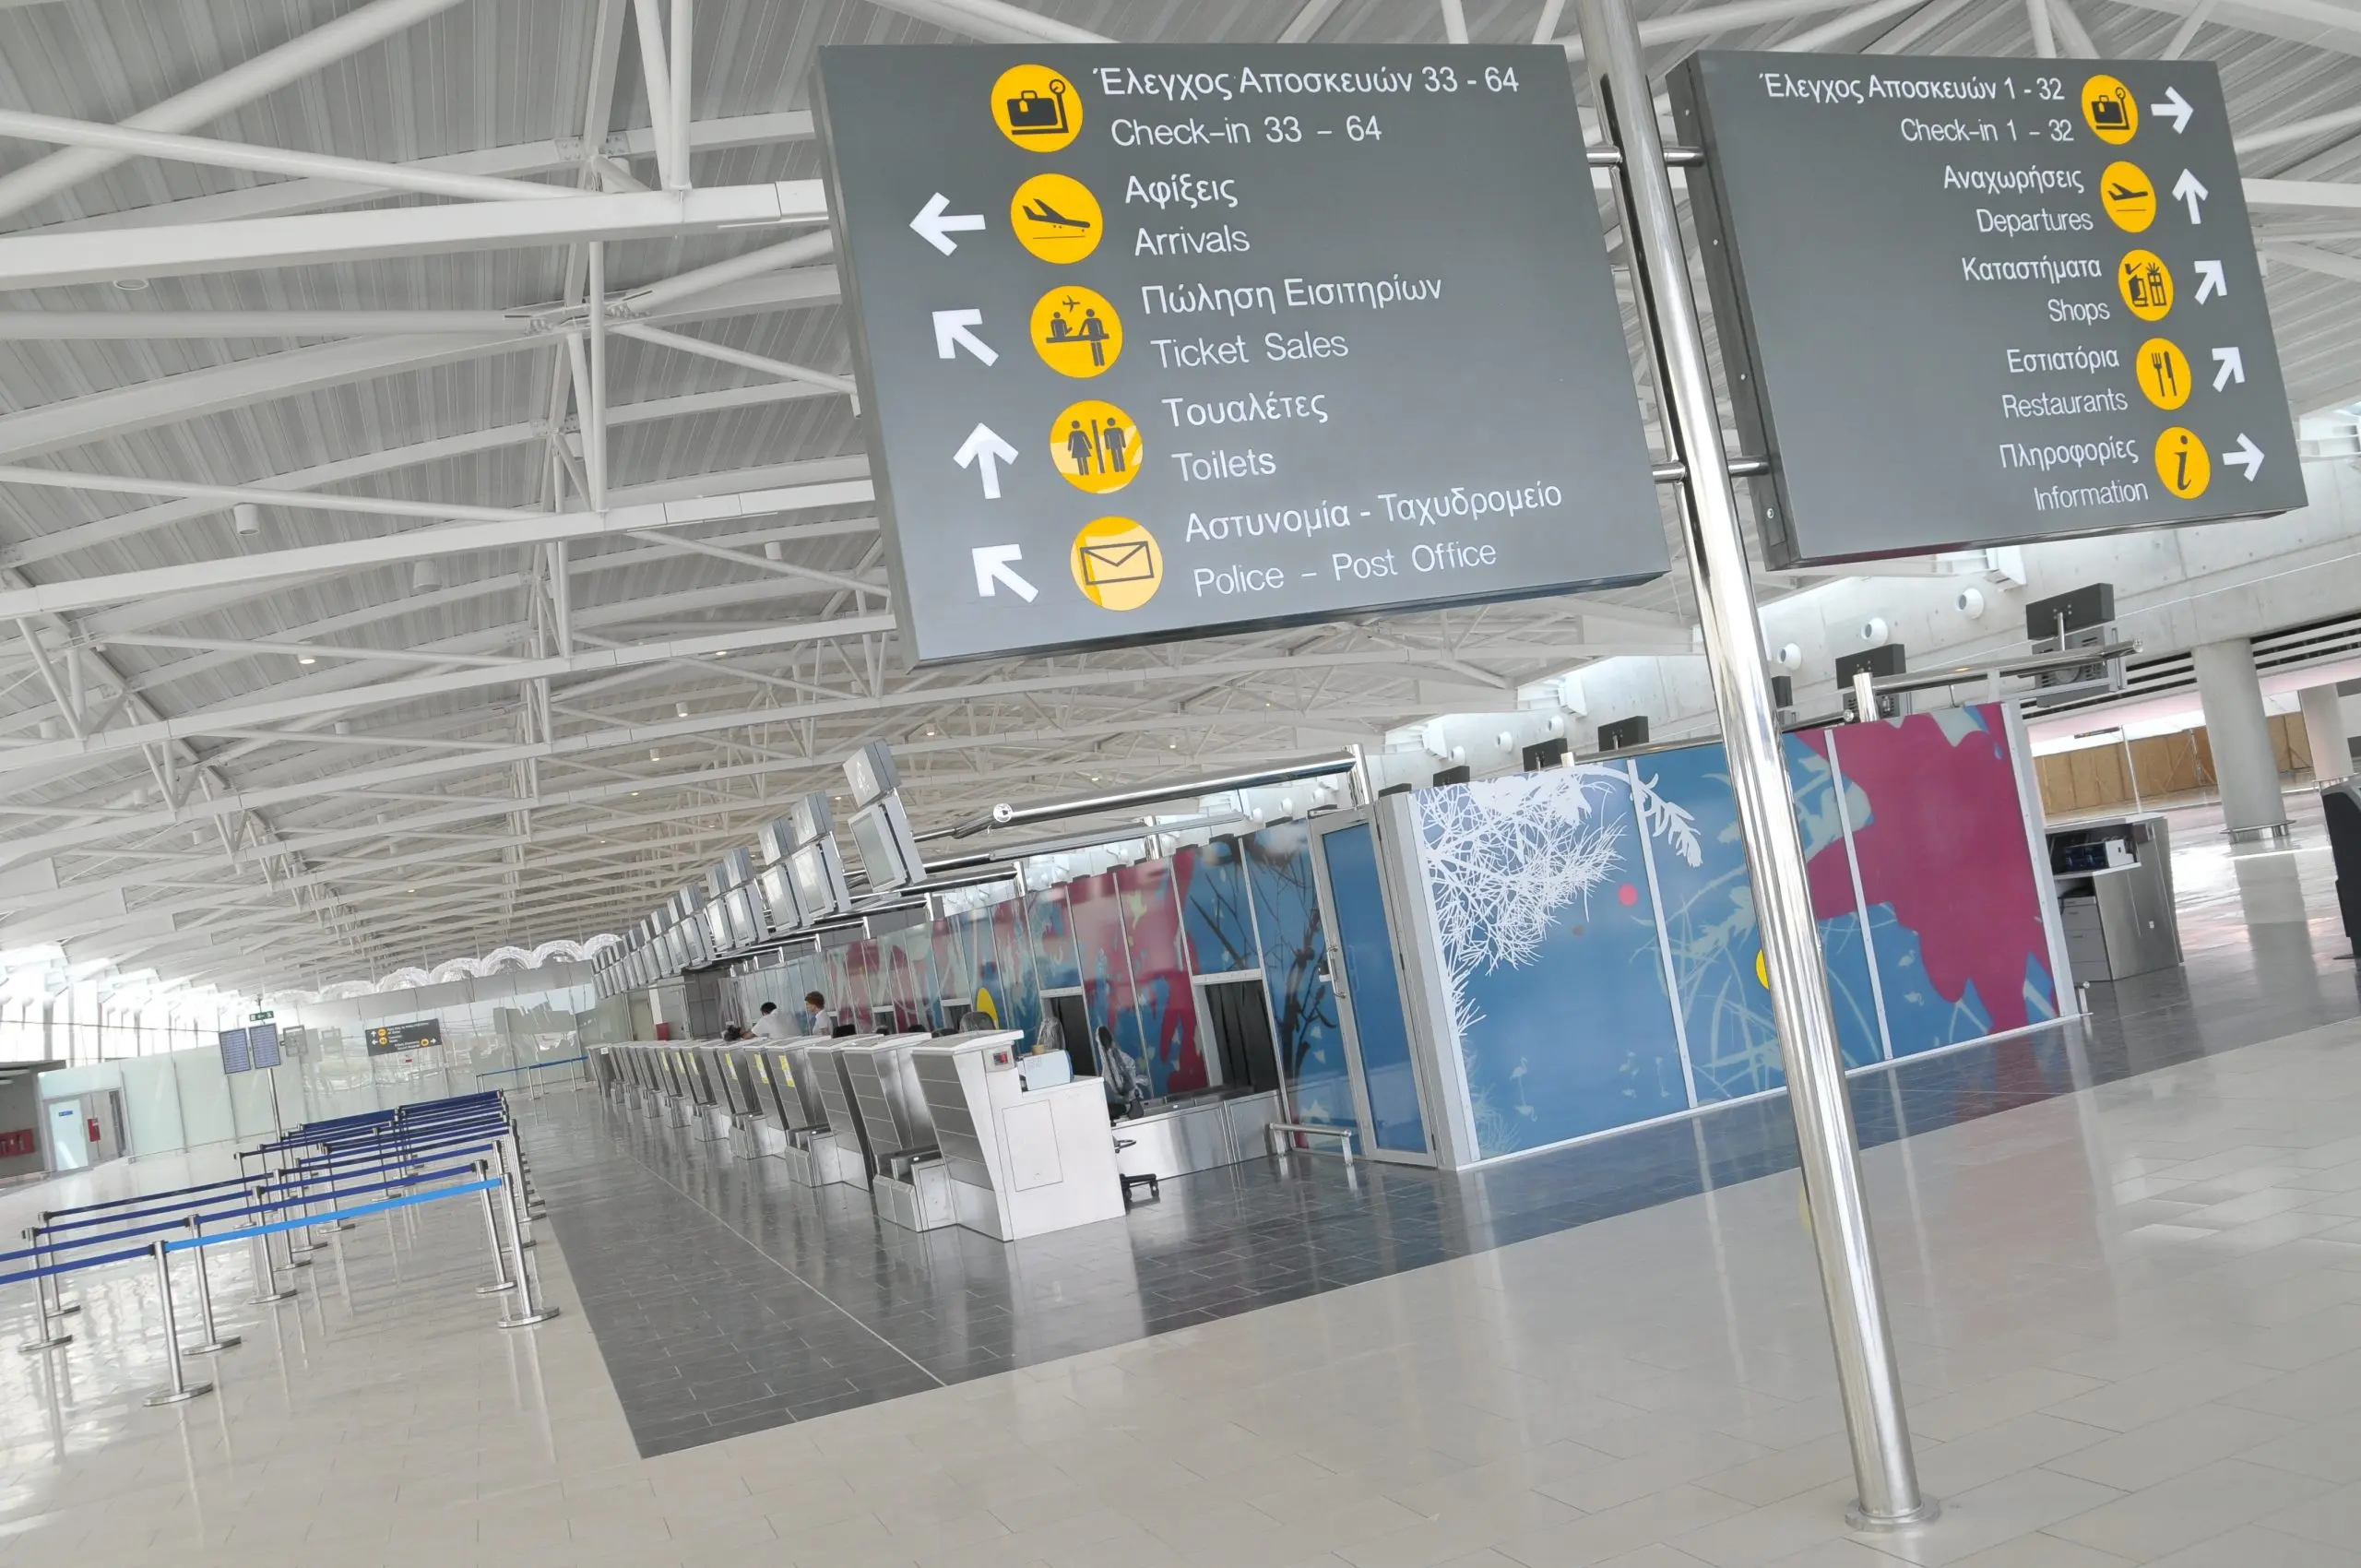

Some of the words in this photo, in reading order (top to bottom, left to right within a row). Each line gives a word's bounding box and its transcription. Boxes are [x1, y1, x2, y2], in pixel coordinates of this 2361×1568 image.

[1092, 67, 1233, 101] Έλεγχος
[1240, 66, 1413, 93] Αποσκευών
[1421, 66, 1458, 92] 33
[1484, 66, 1520, 92] 64
[1759, 73, 1865, 104] Έλεγχος
[1869, 75, 1997, 100] Αποσκευών
[2004, 77, 2016, 100] 1
[2036, 77, 2065, 101] 32
[1110, 117, 1252, 147] Check-in
[1264, 116, 1302, 143] 33
[1346, 114, 1382, 142] 64
[1900, 117, 1999, 142] Check-in
[2006, 119, 2017, 141] 1
[2048, 119, 2074, 142] 32
[1125, 173, 1239, 209] Αφίξεις
[1943, 164, 2084, 195] Αναχωρήσεις
[1975, 208, 2094, 238] Departures
[1134, 224, 1251, 256] Arrivals
[1961, 255, 2103, 284] Καταστήματα
[1141, 282, 1276, 317] Πώληση
[1283, 273, 1442, 308] Εισιτηρίων
[2047, 298, 2111, 326] Shops
[1149, 335, 1251, 369] Ticket
[1264, 332, 1349, 362] Sales
[2006, 345, 2120, 374] Εστιατόρια
[1160, 390, 1329, 428] Τουαλέτες
[2001, 387, 2129, 419] Restaurants
[1170, 448, 1277, 488] Toilets
[1999, 435, 2140, 472] Πληροφορίες
[2033, 480, 2149, 511] Information
[1185, 501, 1351, 543] Αστυνομία
[1378, 481, 1562, 527] Ταχυδρομείο
[1193, 564, 1285, 598] Police
[1332, 551, 1398, 581] Post
[1412, 540, 1497, 573] Office
